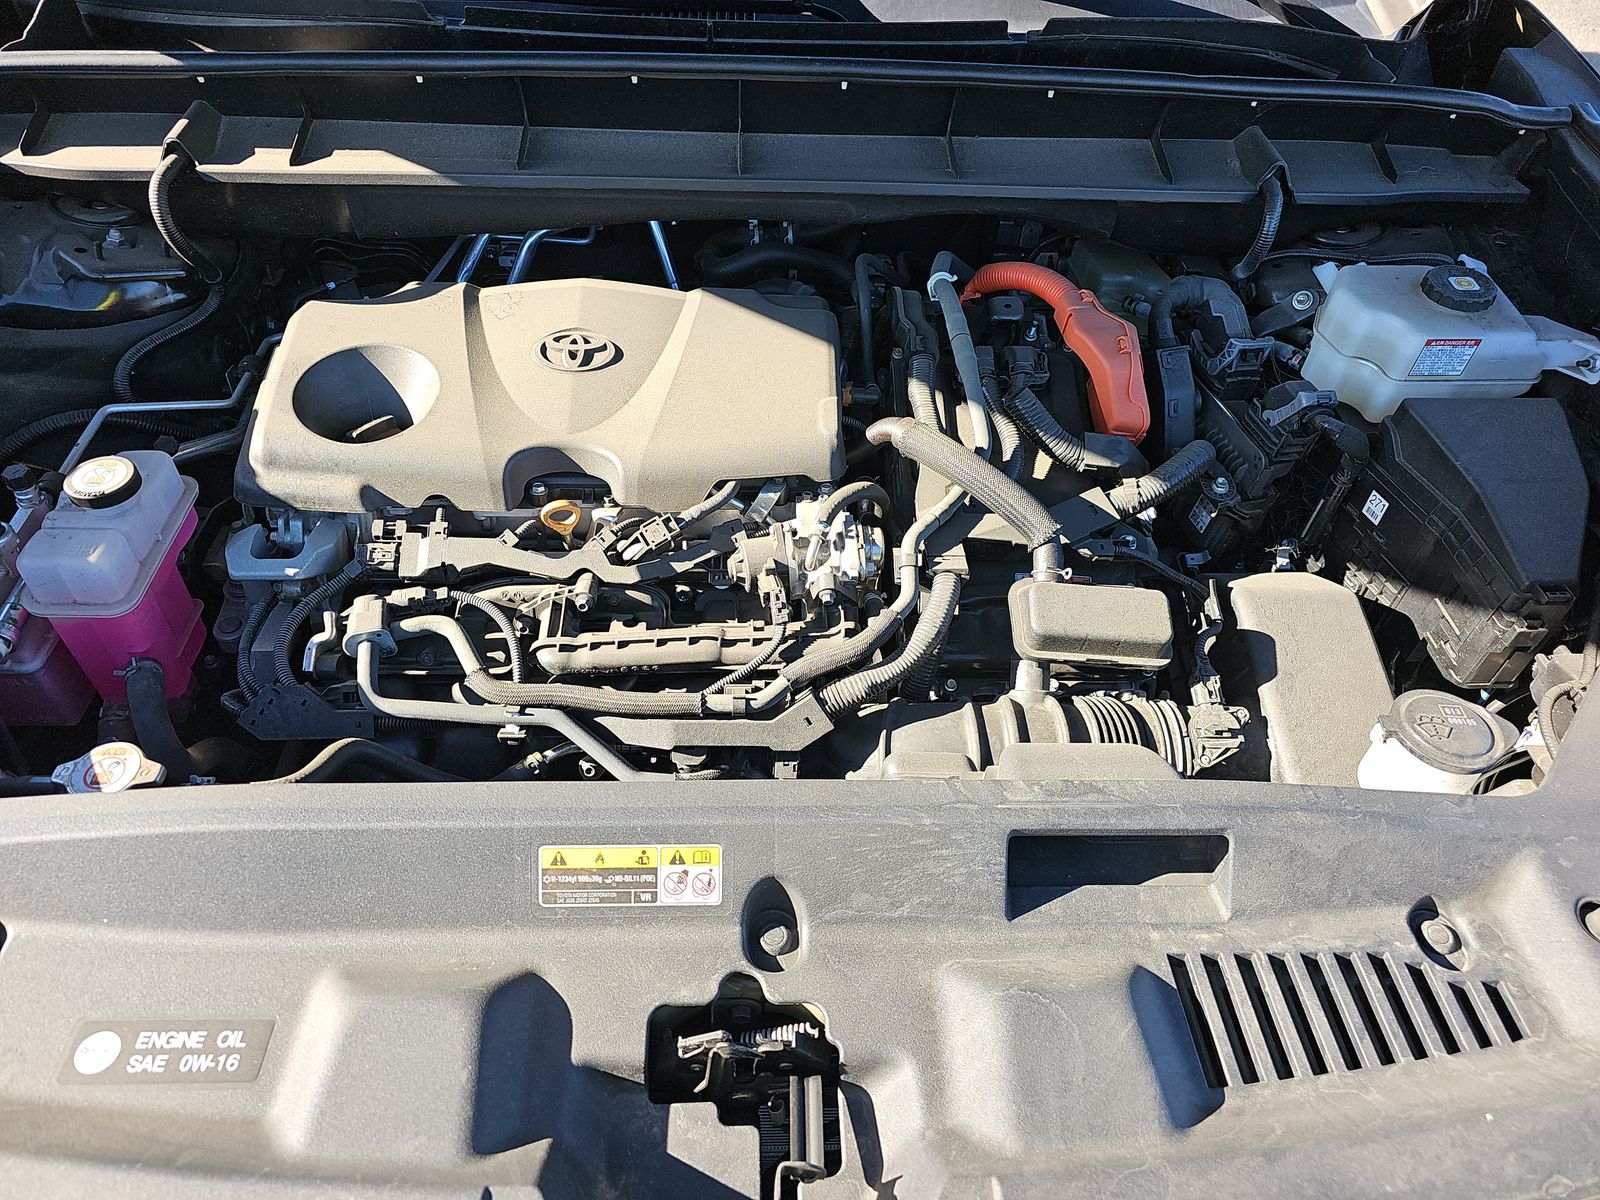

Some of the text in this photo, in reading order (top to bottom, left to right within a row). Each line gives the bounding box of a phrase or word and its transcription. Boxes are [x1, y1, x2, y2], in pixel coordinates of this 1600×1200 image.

[1369, 494, 1386, 513] 271
[639, 892, 652, 902] VR
[135, 1030, 247, 1050] ENGINE OIL
[126, 1053, 241, 1073] SAE 0W-16
